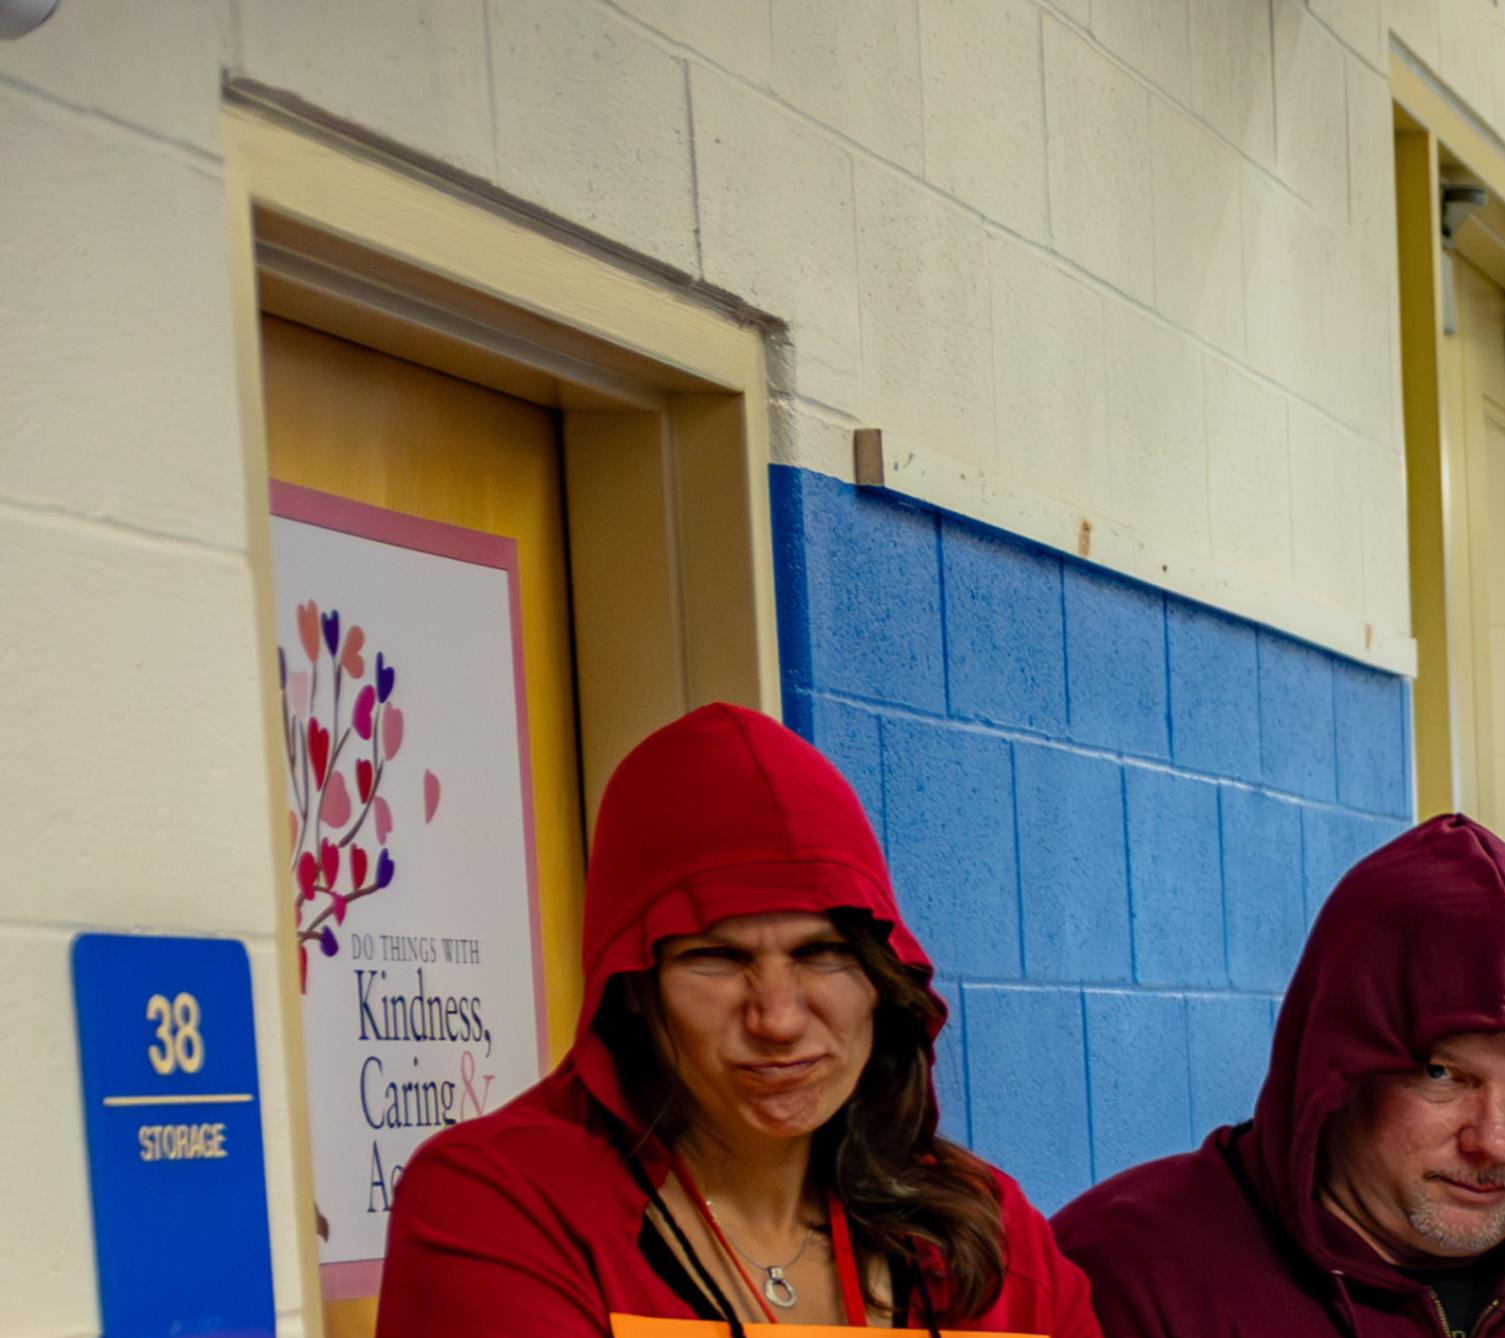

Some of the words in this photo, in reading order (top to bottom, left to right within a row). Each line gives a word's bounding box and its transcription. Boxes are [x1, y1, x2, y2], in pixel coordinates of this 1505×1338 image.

[351, 933, 374, 960] DO
[379, 934, 438, 963] THINGS
[441, 938, 481, 964] WITH
[146, 991, 205, 1075] 38
[353, 966, 492, 1058] Kindness,
[360, 1056, 457, 1130] Caring
[138, 1122, 228, 1162] STORAGE
